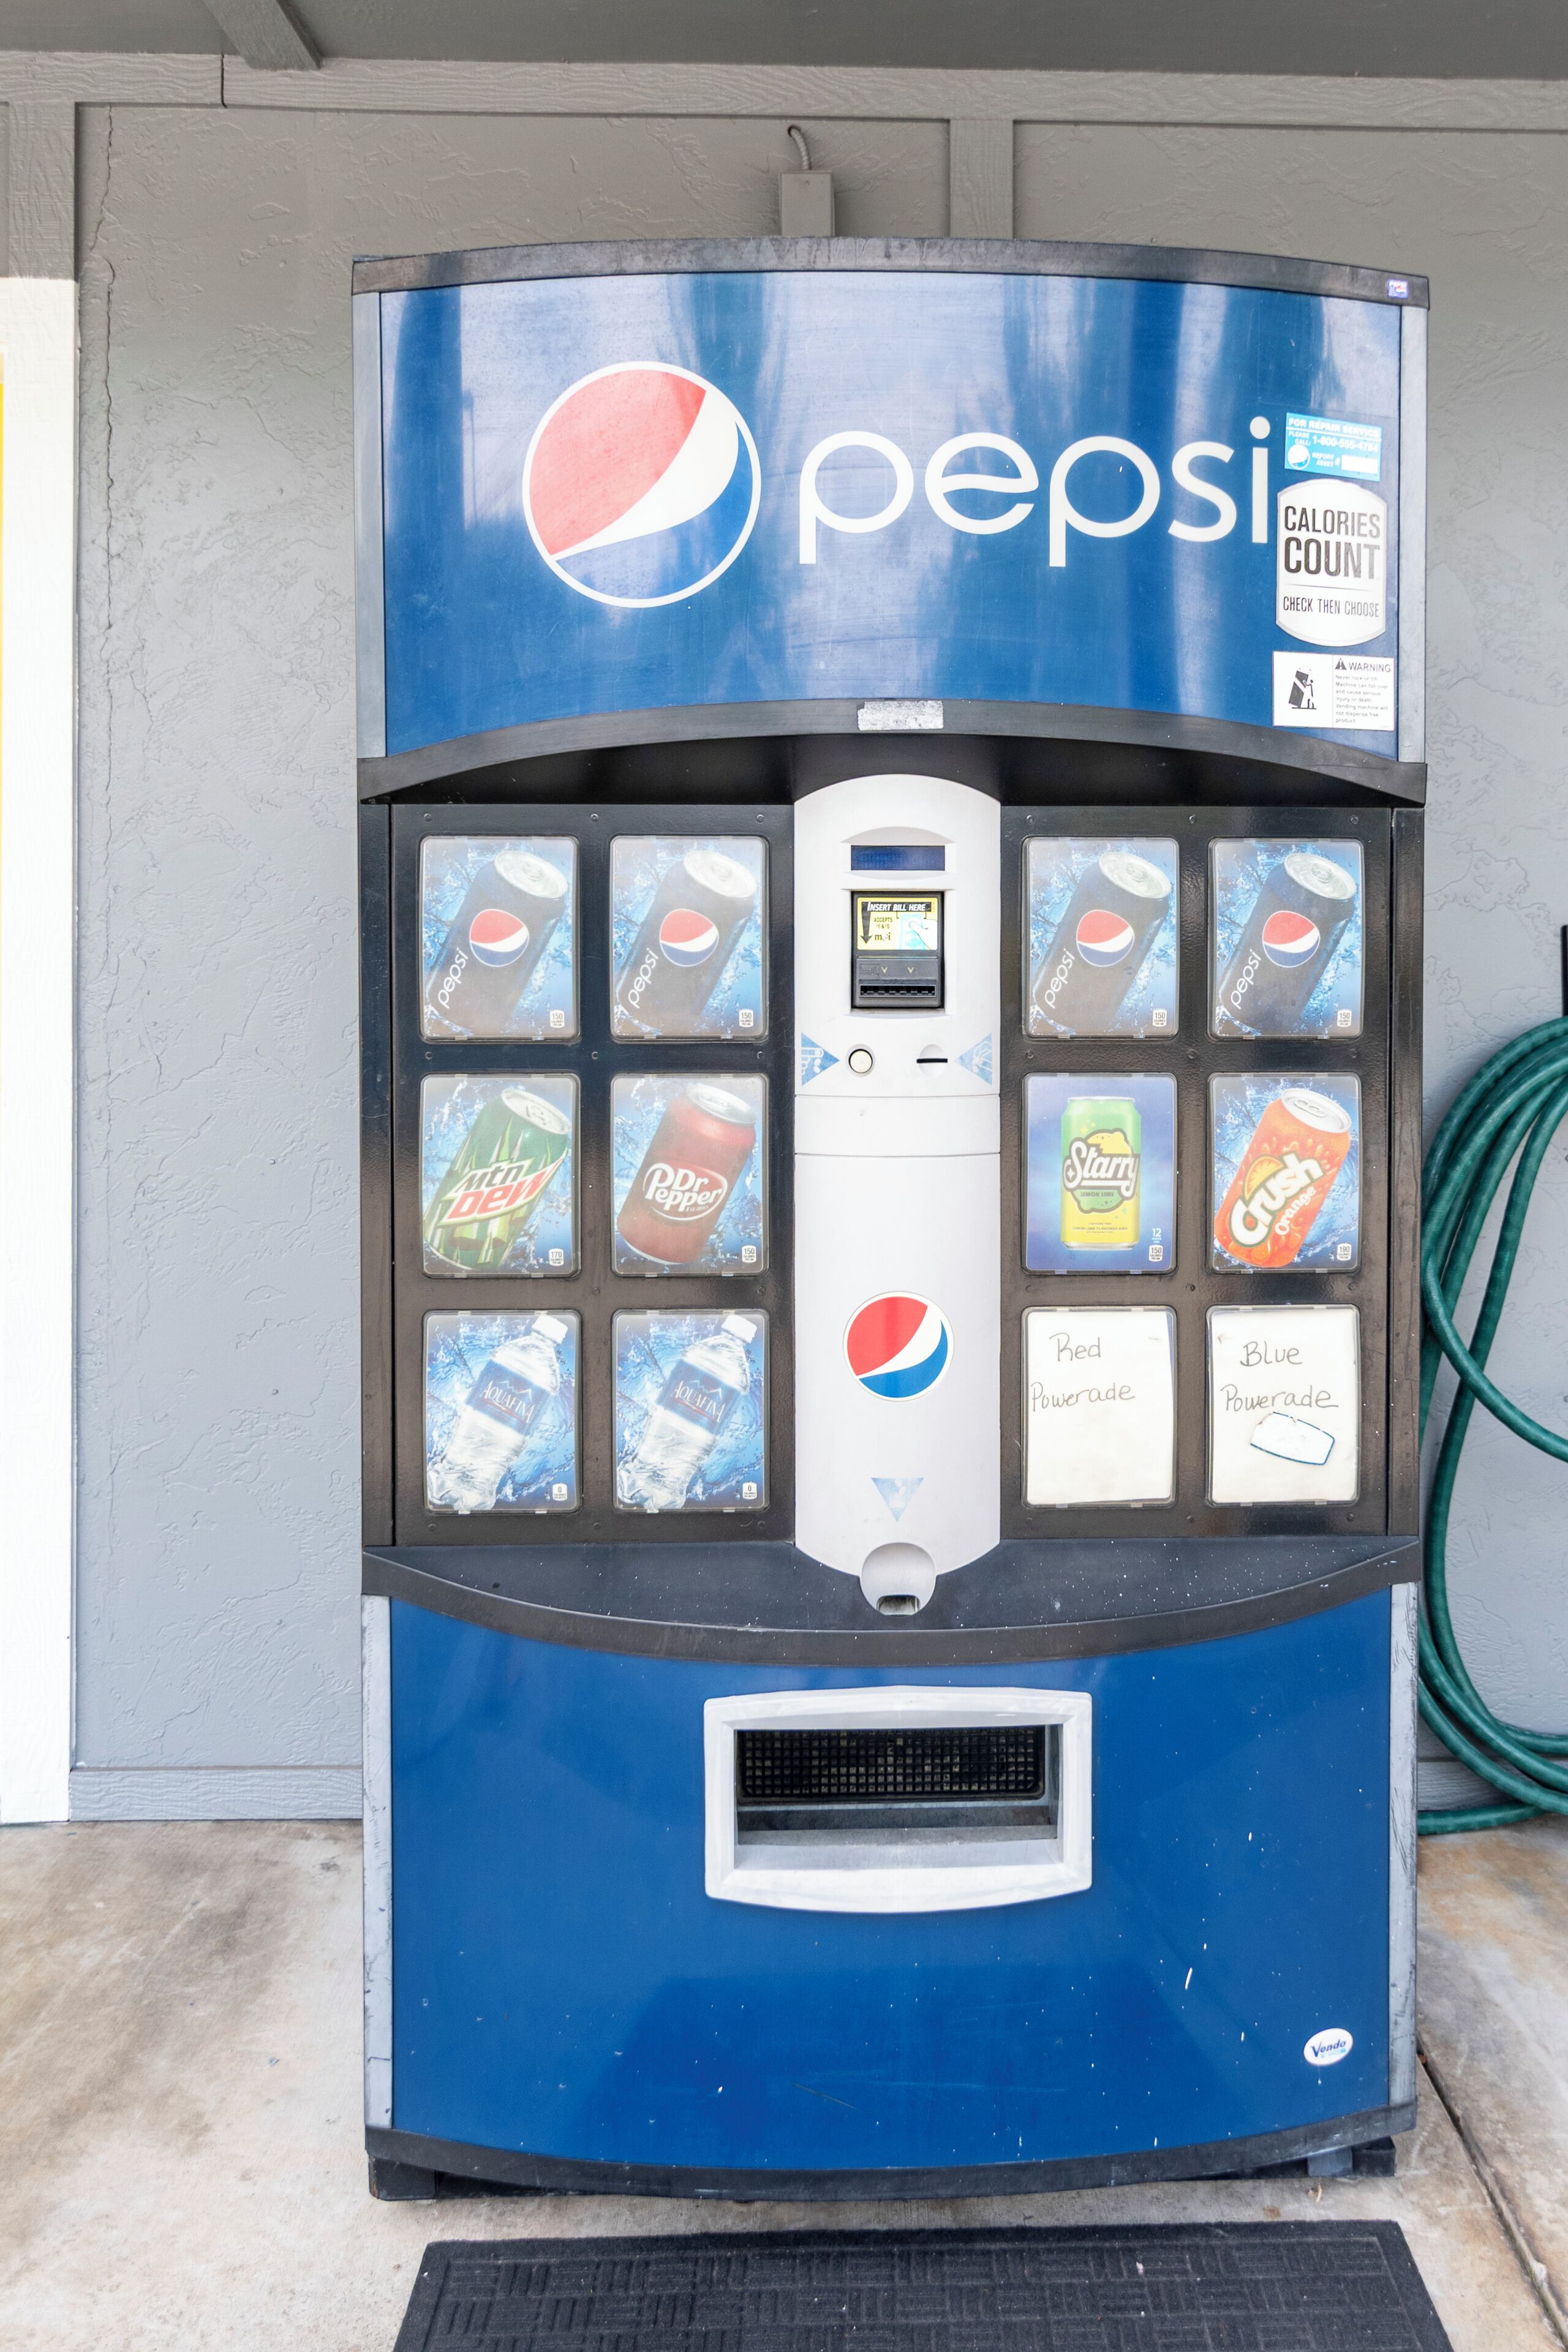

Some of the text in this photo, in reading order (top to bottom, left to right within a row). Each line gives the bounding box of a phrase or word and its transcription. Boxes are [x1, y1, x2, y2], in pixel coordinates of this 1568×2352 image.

[1288, 418, 1379, 438] FOR REPAIR SERVICE
[799, 416, 1270, 567] pepsi
[1284, 506, 1381, 539] CALORIES
[1284, 537, 1380, 579] COUNT
[1283, 596, 1379, 617] CHECK THEN CHOOSE
[1349, 662, 1391, 673] WARNING
[867, 902, 892, 911] INSERT
[438, 948, 469, 1009] pepsi
[628, 948, 659, 1009] pepsi
[1044, 948, 1076, 1009] pepsi
[1231, 948, 1261, 1009] pepsi
[644, 1163, 723, 1212] Pepper
[671, 1168, 709, 1191] Dr
[1064, 1141, 1139, 1197] Starry
[1231, 1152, 1324, 1245] Crush
[1275, 1186, 1317, 1235] Orange
[1152, 1227, 1162, 1237] 12
[1049, 1332, 1101, 1362] Red
[1240, 1341, 1302, 1366] Blue
[480, 1381, 535, 1423] AQUAFINA
[670, 1381, 726, 1423] AQUAFINA
[1030, 1382, 1135, 1412] Powerade
[1220, 1384, 1339, 1412] Powerade
[1310, 2038, 1346, 2057] Vendo
